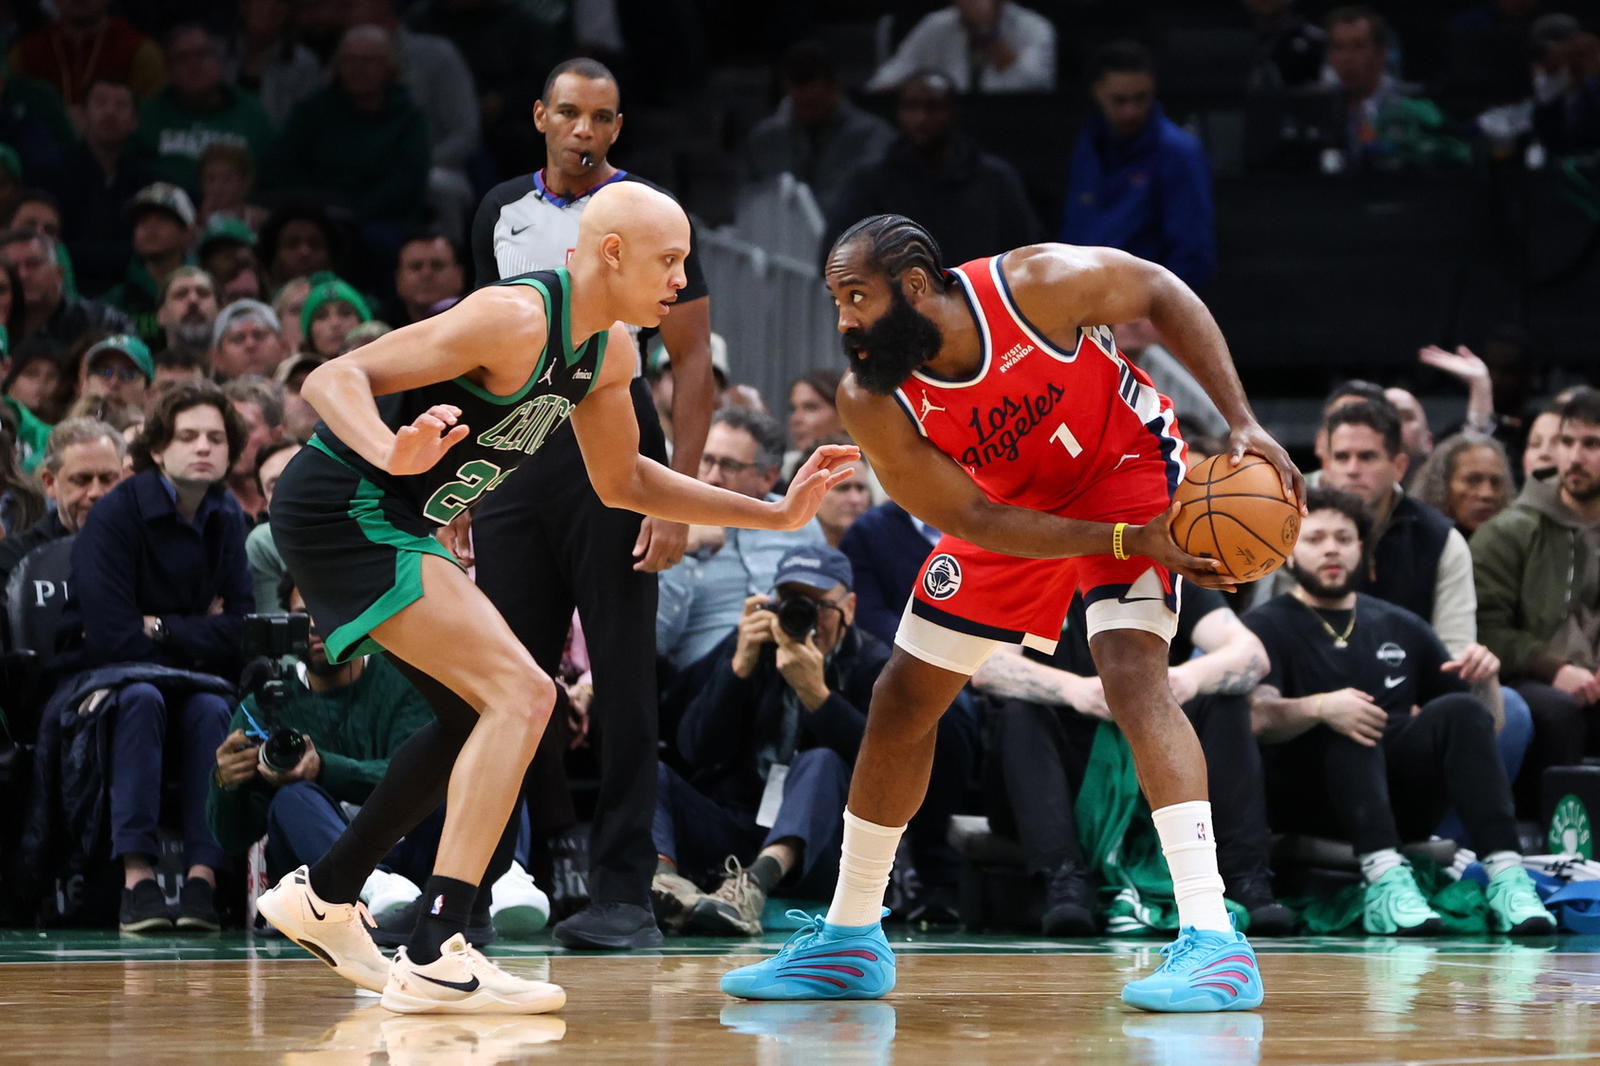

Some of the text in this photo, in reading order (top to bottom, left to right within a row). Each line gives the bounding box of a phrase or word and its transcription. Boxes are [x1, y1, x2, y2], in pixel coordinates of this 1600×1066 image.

[1000, 344, 1035, 373] RWANDA
[1001, 343, 1023, 361] VISIT
[968, 396, 1021, 445] Los
[1049, 422, 1083, 459] 1
[423, 459, 519, 525] 2
